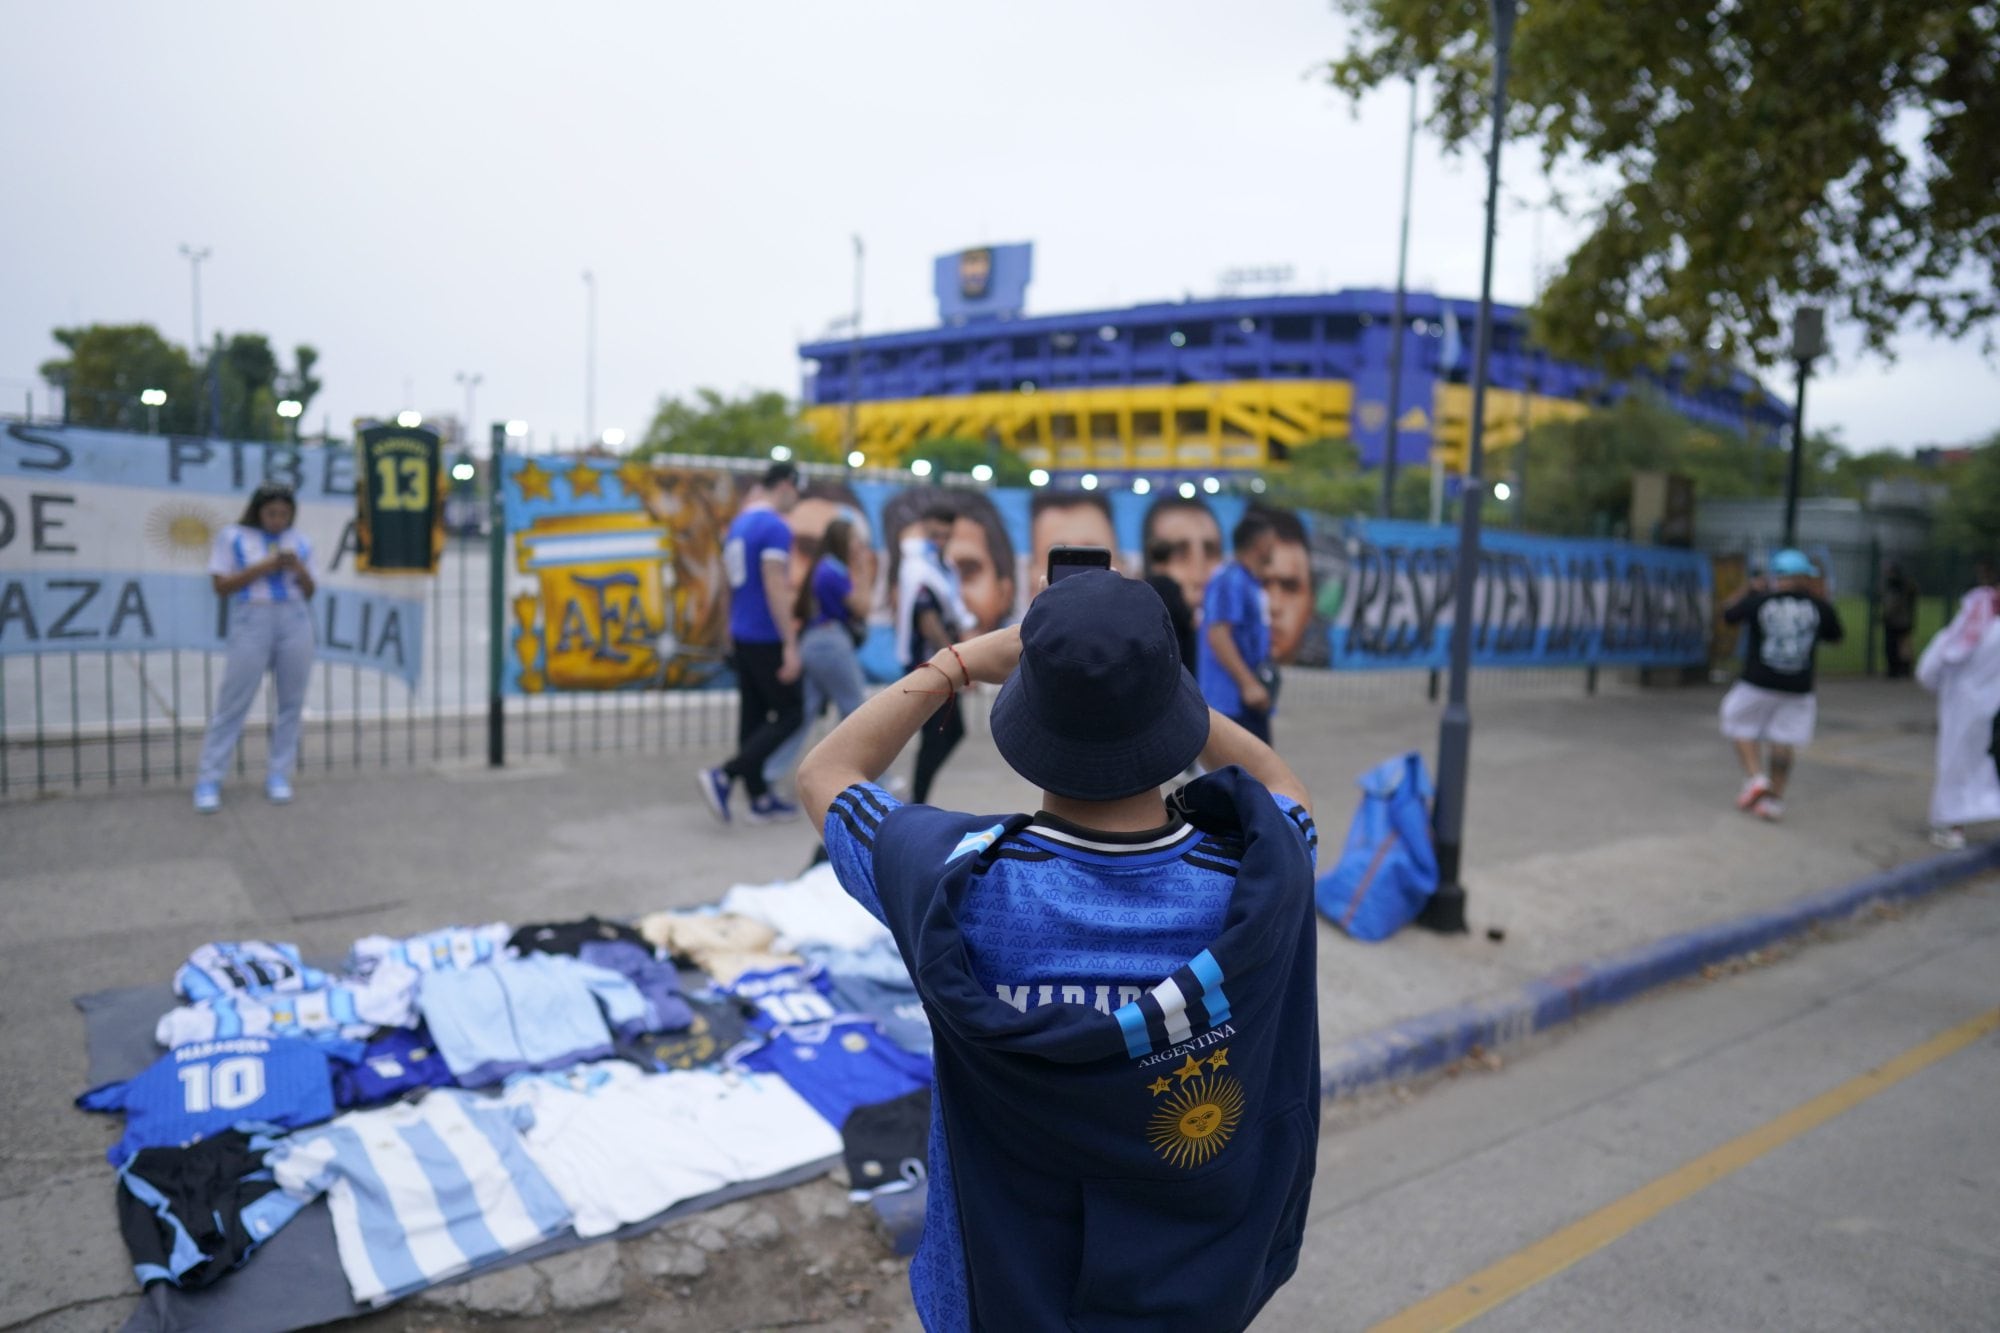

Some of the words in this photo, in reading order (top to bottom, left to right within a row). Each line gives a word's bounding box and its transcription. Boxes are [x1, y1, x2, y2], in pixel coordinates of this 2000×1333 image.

[376, 456, 429, 512] 13
[556, 572, 662, 662] AFA
[1139, 1023, 1236, 1068] ARGENTINA
[178, 1056, 266, 1113] 10
